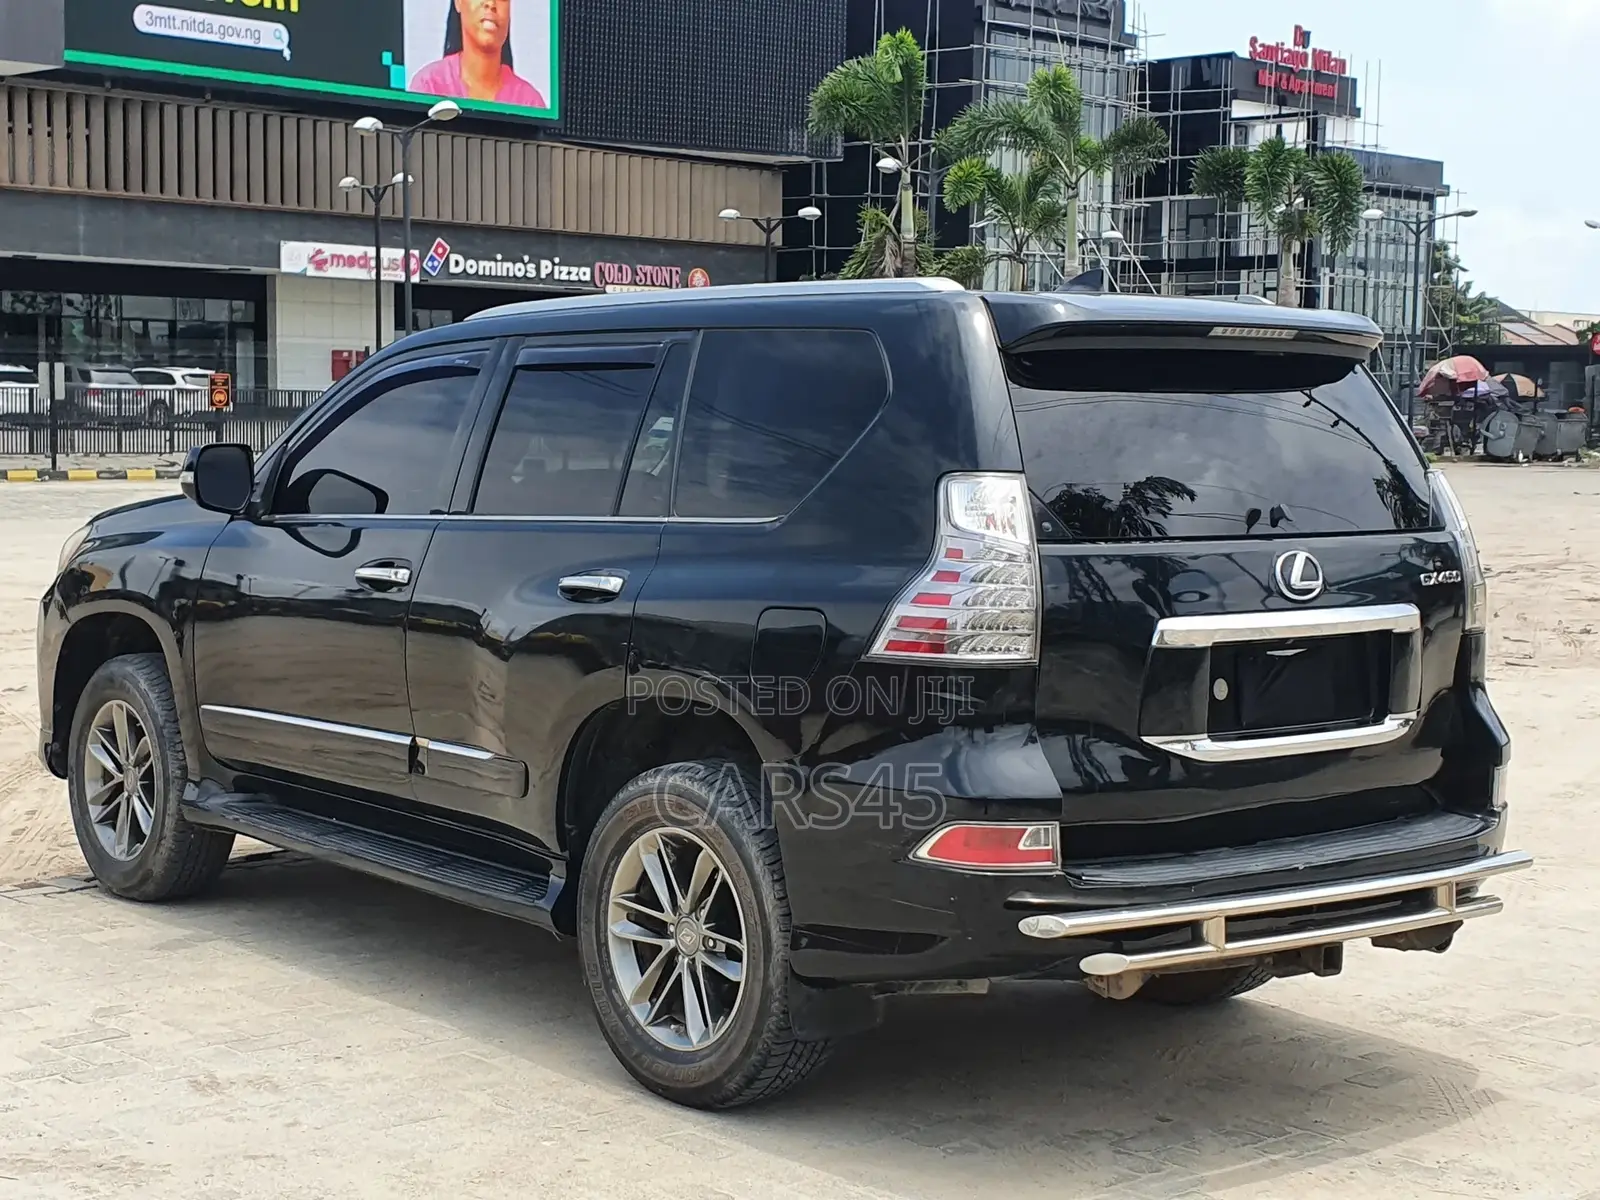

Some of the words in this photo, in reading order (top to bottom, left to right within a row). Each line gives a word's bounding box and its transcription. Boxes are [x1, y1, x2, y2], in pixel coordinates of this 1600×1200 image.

[145, 11, 261, 44] 3mtt.nitda.gov.ng
[1249, 36, 1309, 73] Santiago
[1312, 47, 1347, 75] Milan
[1258, 69, 1280, 88] Mal
[330, 251, 401, 275] medpus
[449, 253, 537, 278] Domino's
[539, 257, 591, 281] Pizza
[594, 262, 632, 288] COLD
[635, 265, 681, 289] STONE
